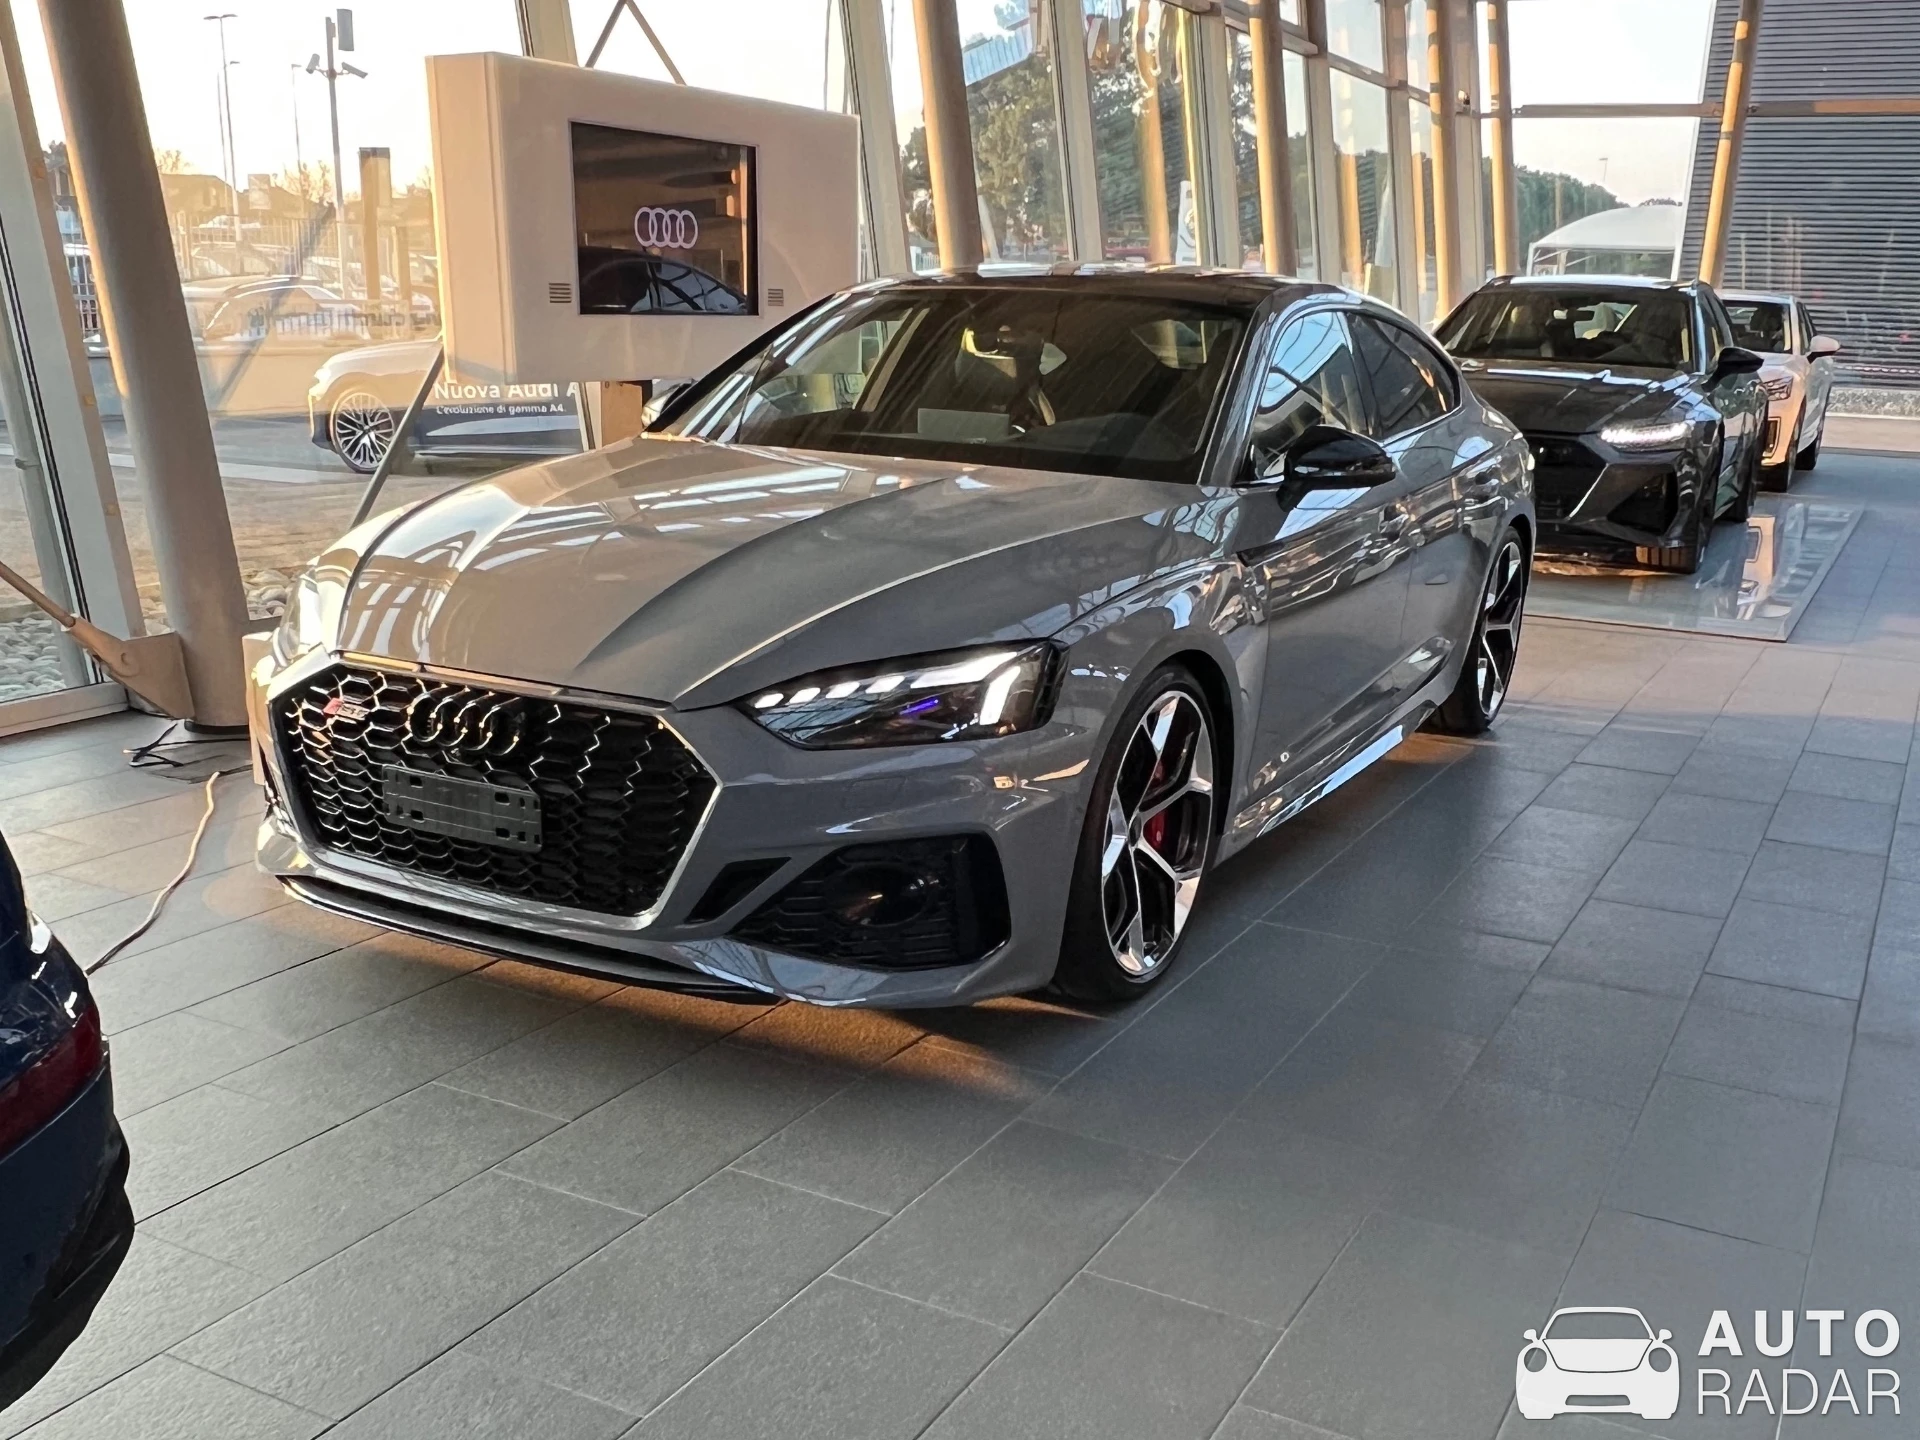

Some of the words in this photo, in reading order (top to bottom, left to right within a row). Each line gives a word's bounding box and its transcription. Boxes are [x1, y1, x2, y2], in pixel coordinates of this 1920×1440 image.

[433, 382, 500, 399] Nuova
[508, 383, 558, 398] Audi
[496, 404, 506, 414] di
[508, 405, 548, 416] gamma
